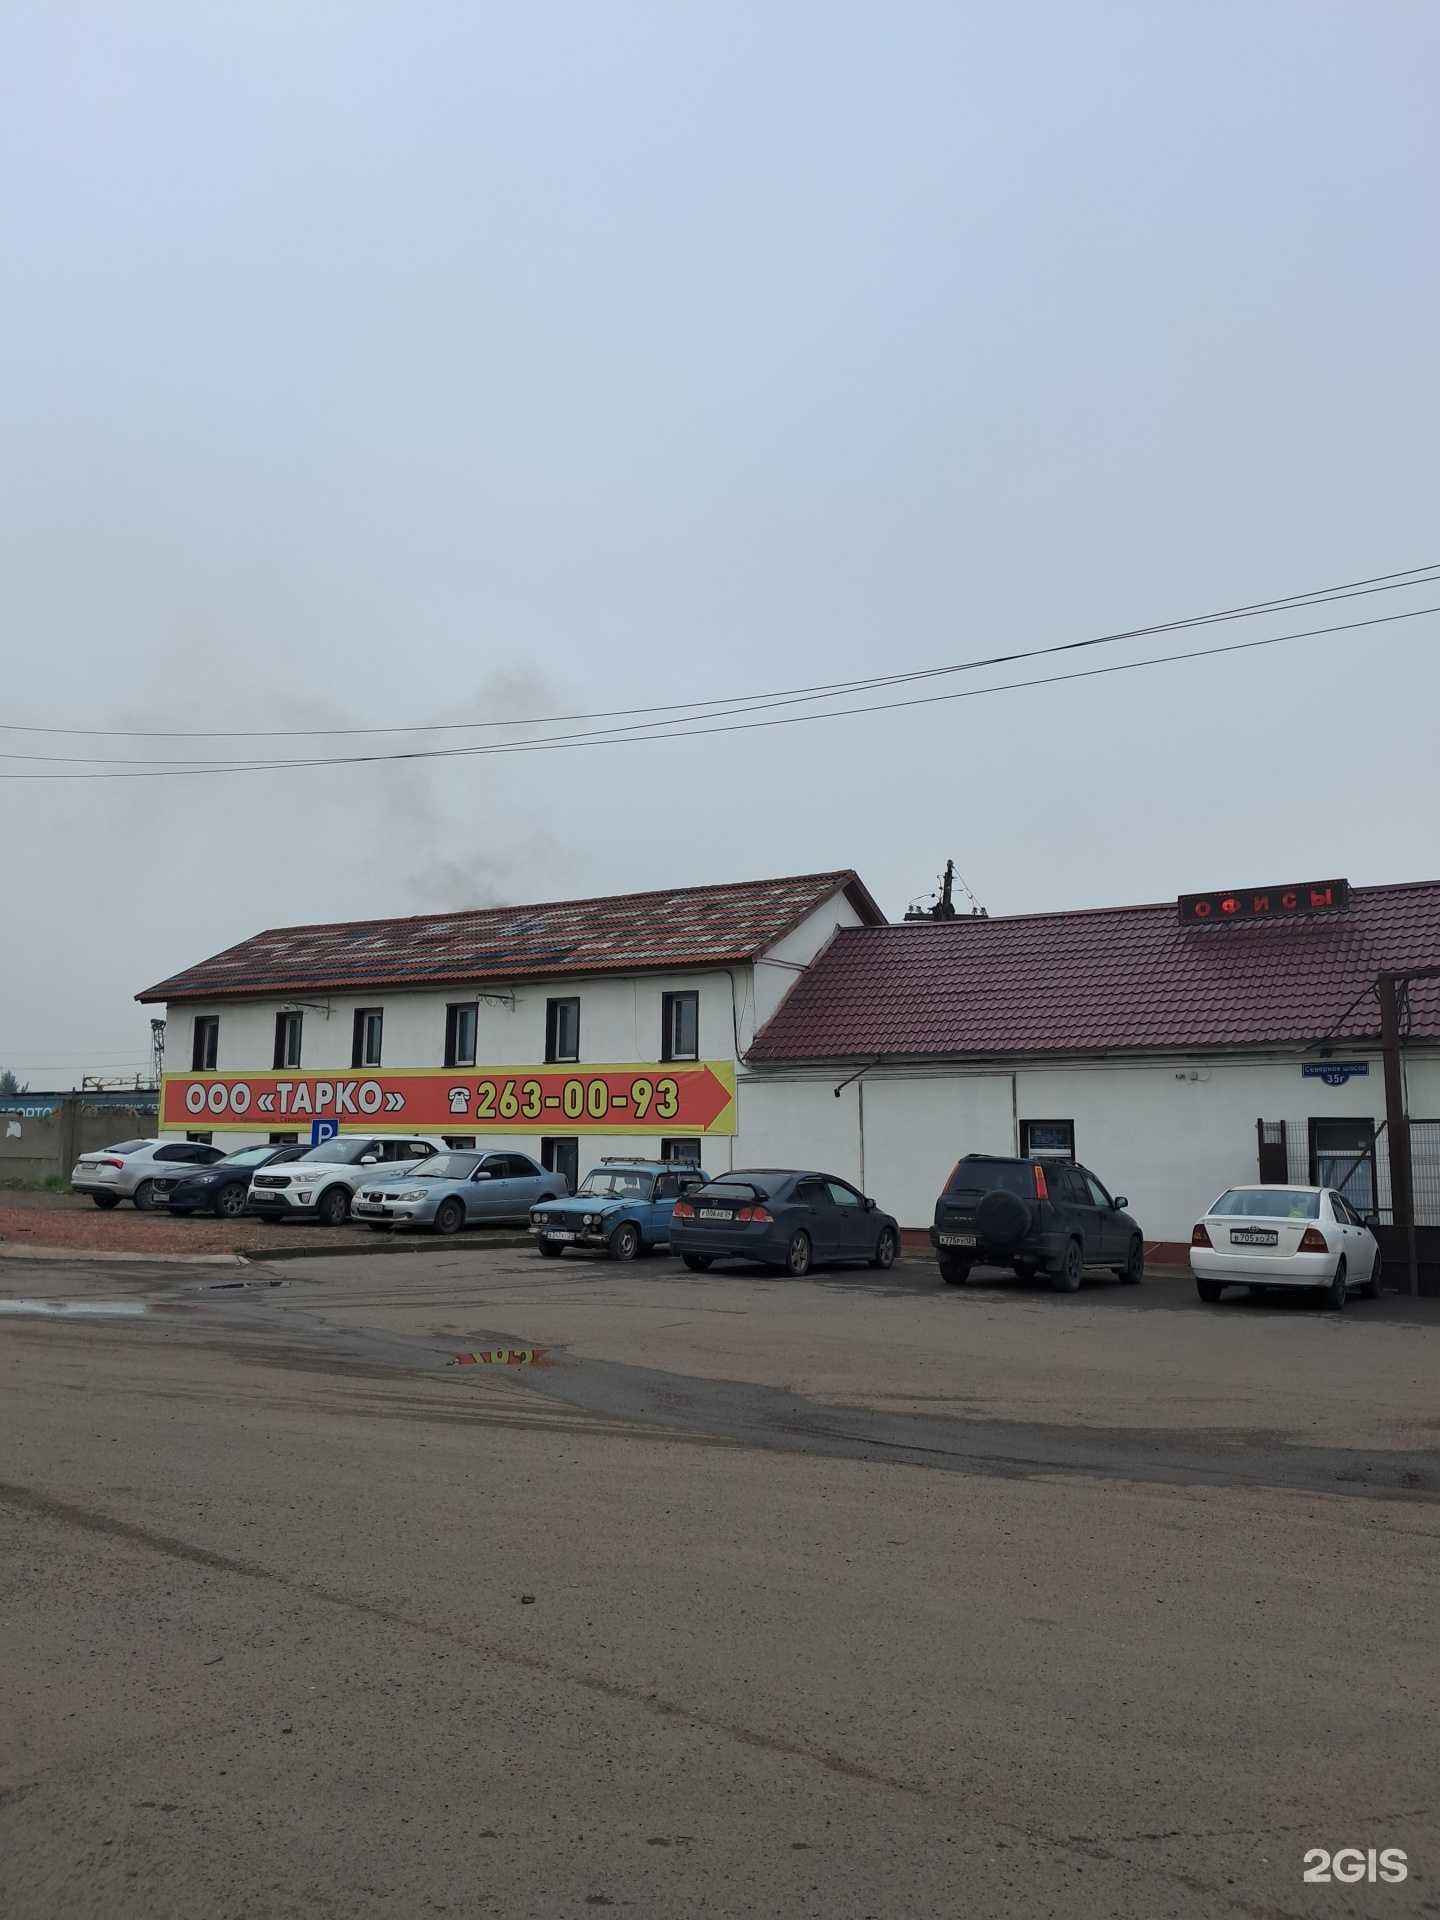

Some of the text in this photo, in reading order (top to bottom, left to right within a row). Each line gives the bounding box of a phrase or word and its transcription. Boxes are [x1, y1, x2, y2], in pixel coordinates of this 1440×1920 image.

[1194, 887, 1333, 918] ОФИСЫ
[185, 1083, 251, 1115] ООО
[256, 1080, 406, 1115] «ТАРКО»
[475, 1077, 680, 1120] 263-00-93
